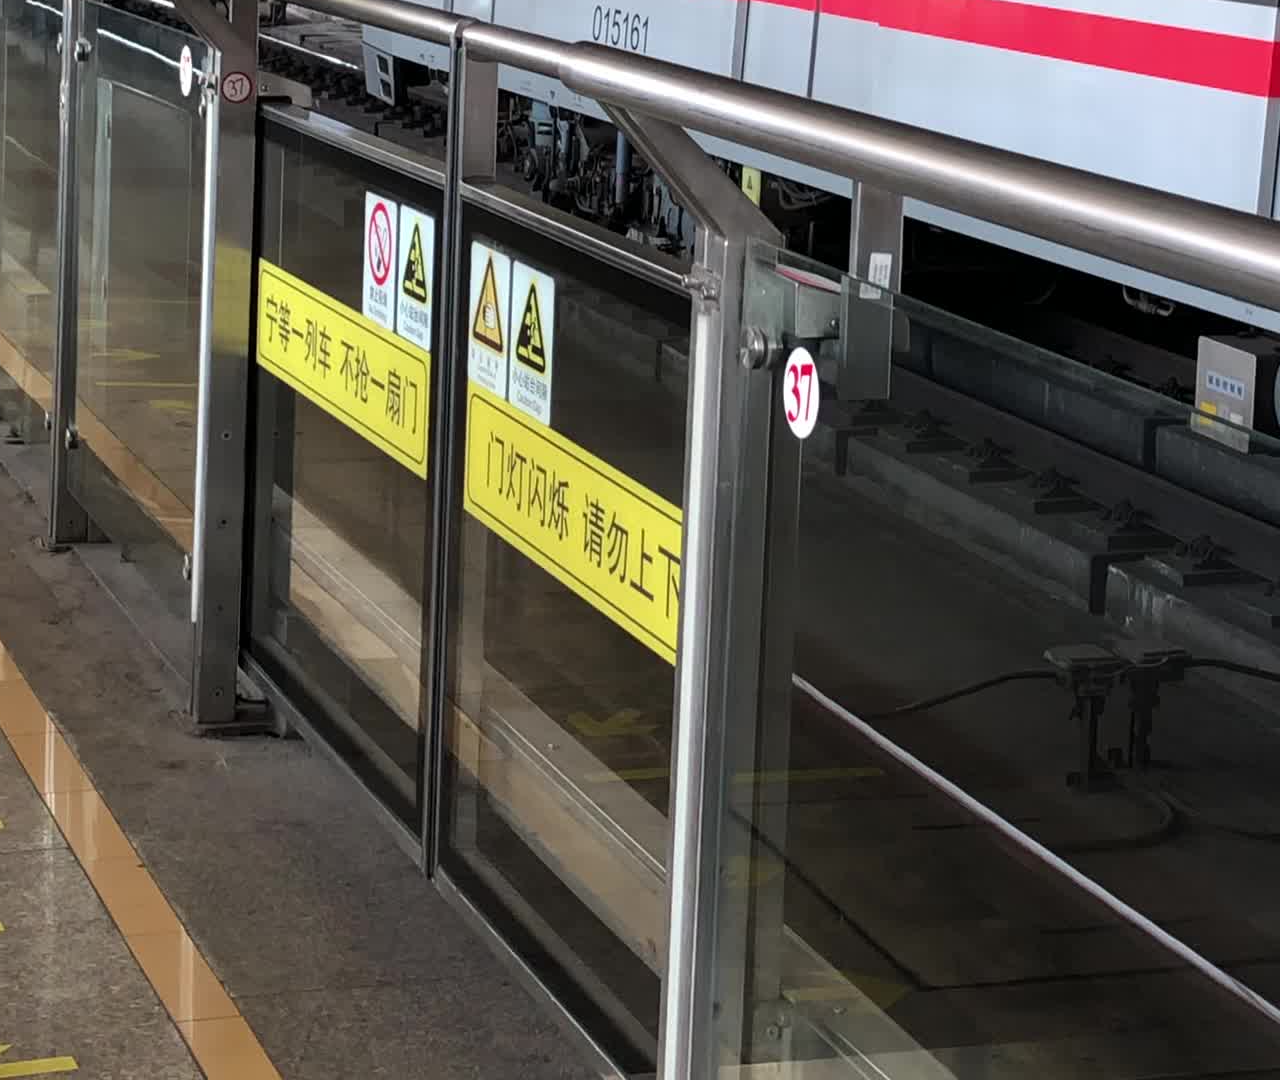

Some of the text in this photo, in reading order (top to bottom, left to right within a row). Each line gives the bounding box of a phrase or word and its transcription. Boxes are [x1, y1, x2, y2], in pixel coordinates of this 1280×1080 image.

[592, 5, 649, 53] 015161
[228, 78, 244, 97] 37
[265, 296, 418, 435] 宁等一列车 不抢一扇门
[787, 364, 813, 422] 37
[487, 432, 570, 541] 门灯闪烁
